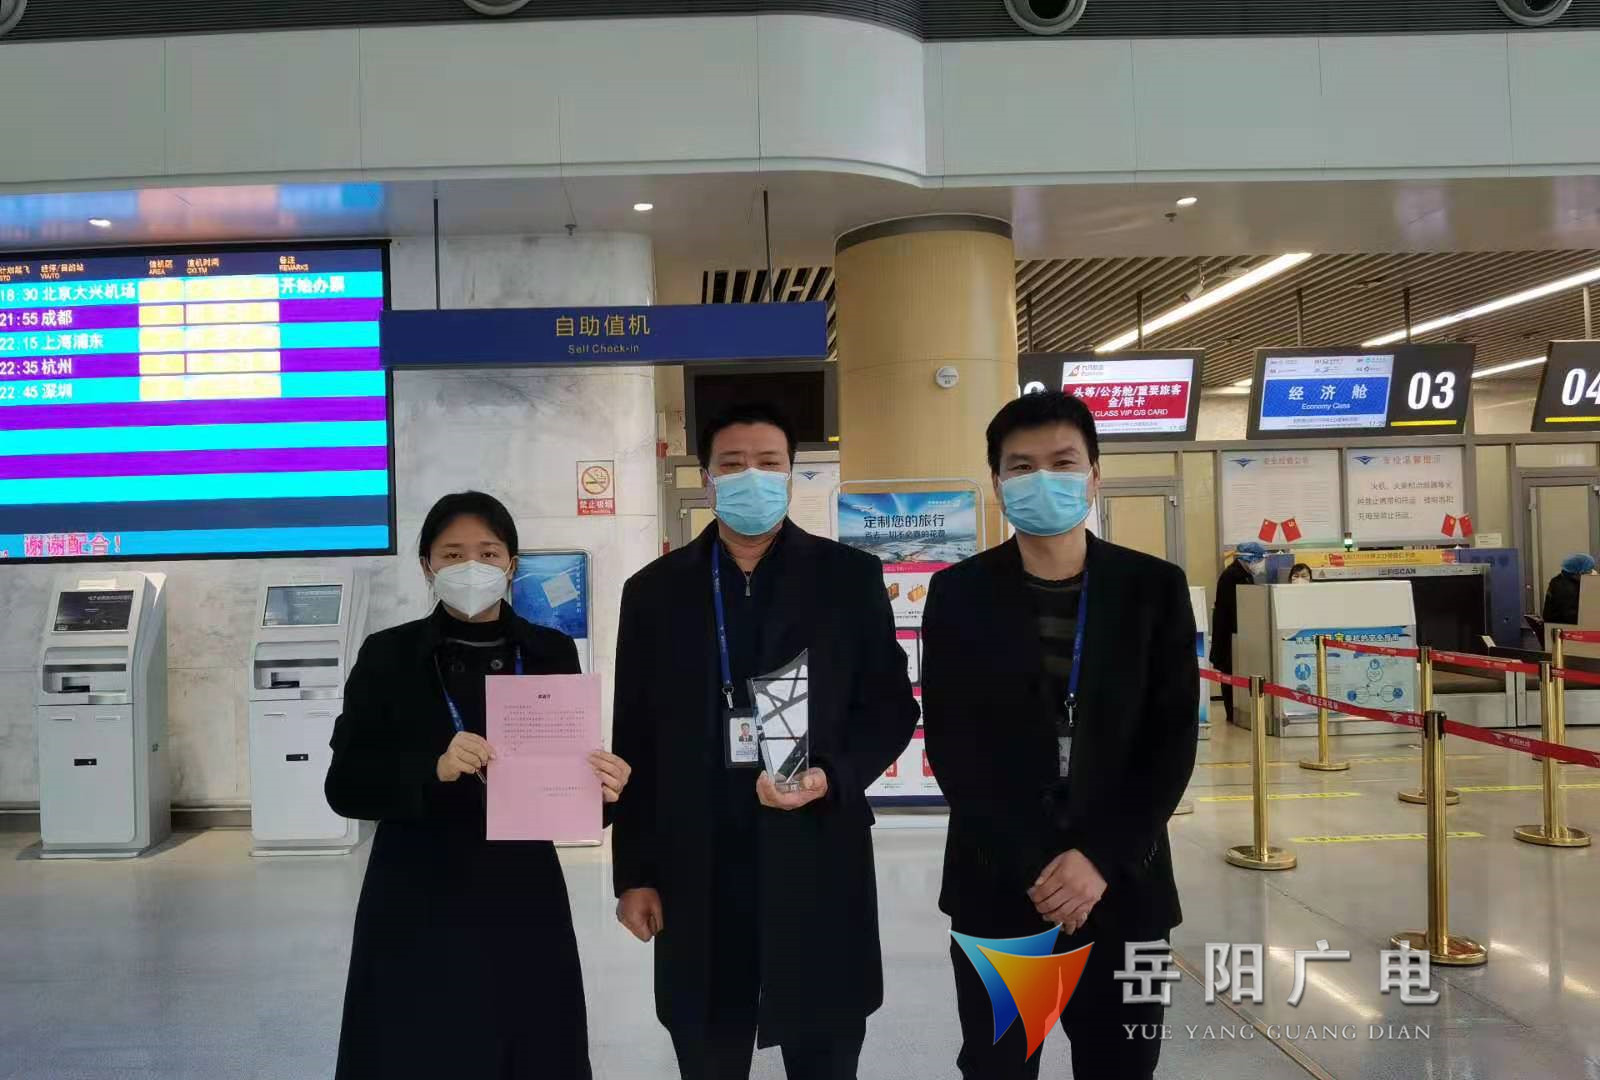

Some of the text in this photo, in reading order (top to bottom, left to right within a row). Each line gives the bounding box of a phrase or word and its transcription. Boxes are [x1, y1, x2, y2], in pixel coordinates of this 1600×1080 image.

[42, 282, 136, 301] 北京大兴机场
[281, 275, 345, 294] 开始办票
[0, 309, 72, 326] 21:55 成都
[556, 314, 650, 336] 自助值机
[42, 333, 103, 350] 上海浦东
[568, 343, 640, 353] Self Check-in
[0, 358, 72, 375] 22:35 杭州
[42, 383, 72, 399] 深圳
[1073, 384, 1182, 398] 头等/公务舱/重要旅客
[1288, 384, 1368, 400] 经济舱
[1407, 371, 1456, 410] 03
[1108, 397, 1146, 408] 金/银卡
[1333, 402, 1351, 410] Class
[1147, 408, 1169, 416] CARD
[863, 514, 945, 528] 定制您的旅行
[25, 532, 121, 556] 谢谢配合！
